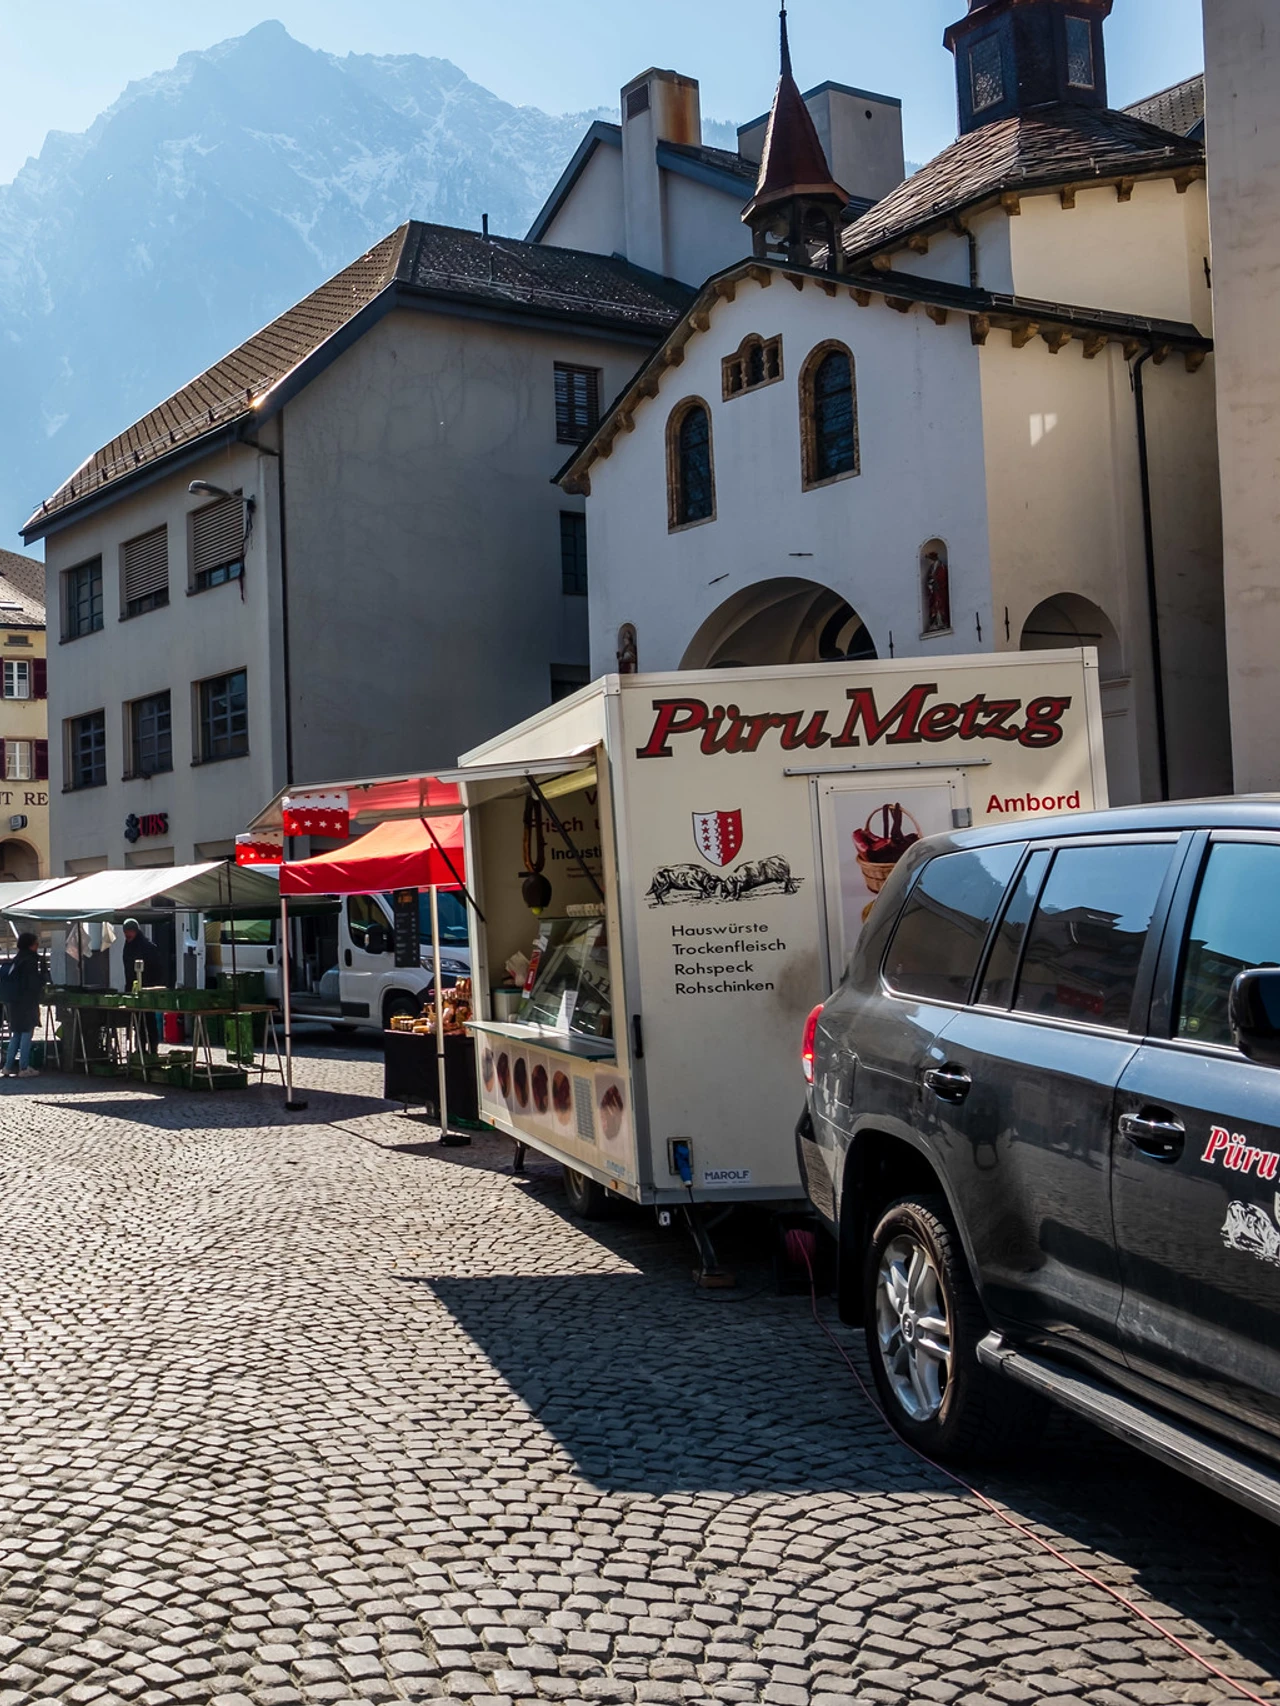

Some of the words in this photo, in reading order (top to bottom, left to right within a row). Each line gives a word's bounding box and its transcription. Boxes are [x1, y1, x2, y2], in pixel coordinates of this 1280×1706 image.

[636, 697, 831, 759] Püru
[831, 683, 1072, 749] Metzg
[24, 792, 48, 806] RE
[986, 791, 1080, 814] Ambord
[139, 812, 169, 838] UBS
[672, 923, 769, 937] Hauswürste
[672, 938, 787, 955] Trockenfleisch
[674, 960, 755, 977] Rohspeck
[675, 979, 775, 995] Rohschinken
[1201, 1125, 1280, 1180] Püru
[704, 1170, 750, 1181] MAROLF
